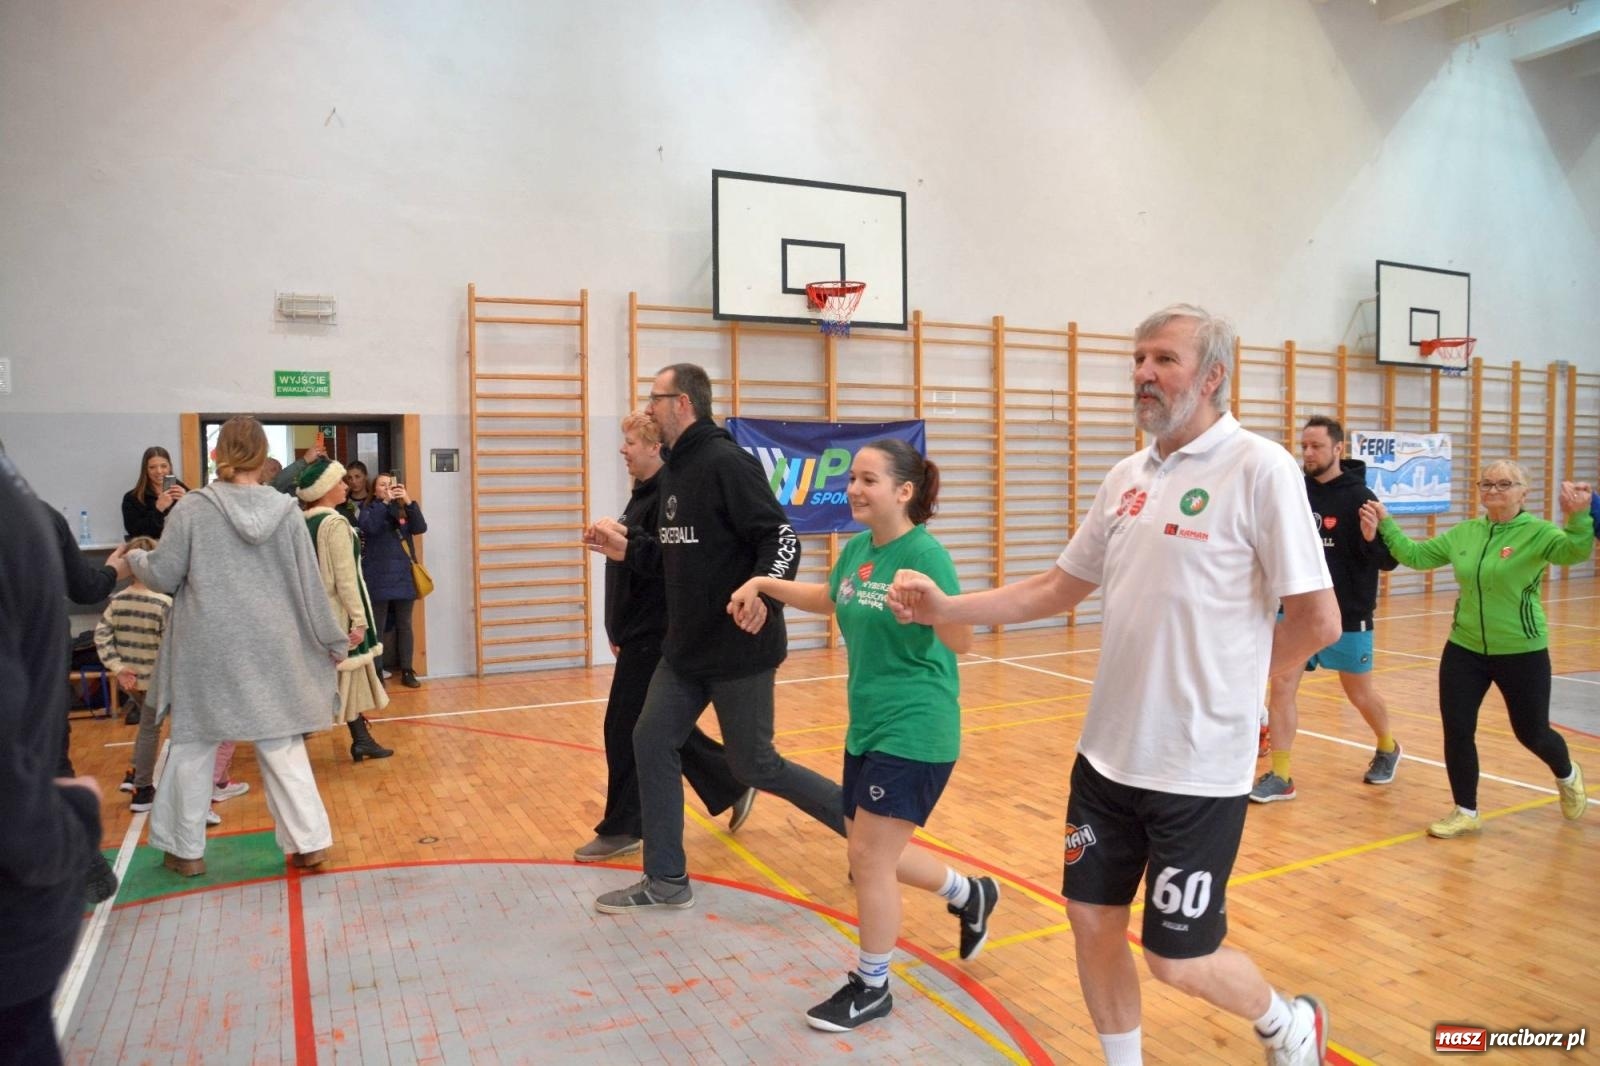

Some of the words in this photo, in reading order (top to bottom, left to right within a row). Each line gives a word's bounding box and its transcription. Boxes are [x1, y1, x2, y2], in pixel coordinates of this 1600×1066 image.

[279, 375, 327, 385] WYJŚCIE
[1359, 438, 1396, 456] FERIE
[767, 524, 797, 579] KIEROWN
[1152, 866, 1212, 919] 60
